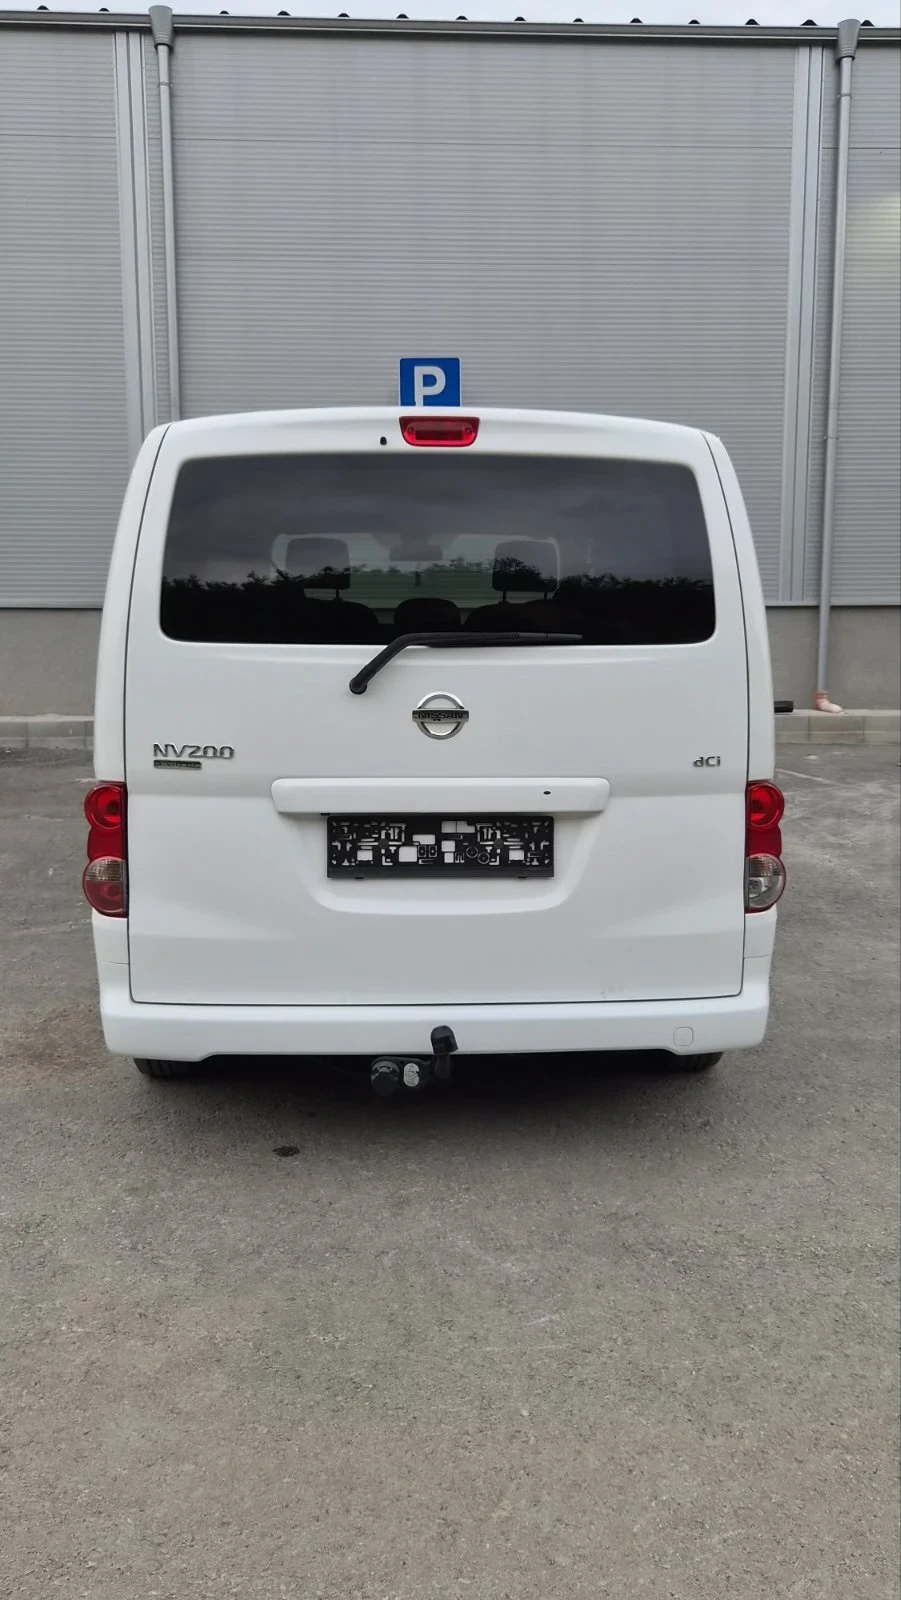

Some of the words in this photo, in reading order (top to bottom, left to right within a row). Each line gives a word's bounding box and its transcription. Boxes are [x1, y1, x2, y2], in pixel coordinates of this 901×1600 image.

[414, 366, 446, 407] P
[417, 711, 464, 719] NISSAN
[153, 743, 235, 760] NV200
[692, 756, 721, 768] dCi
